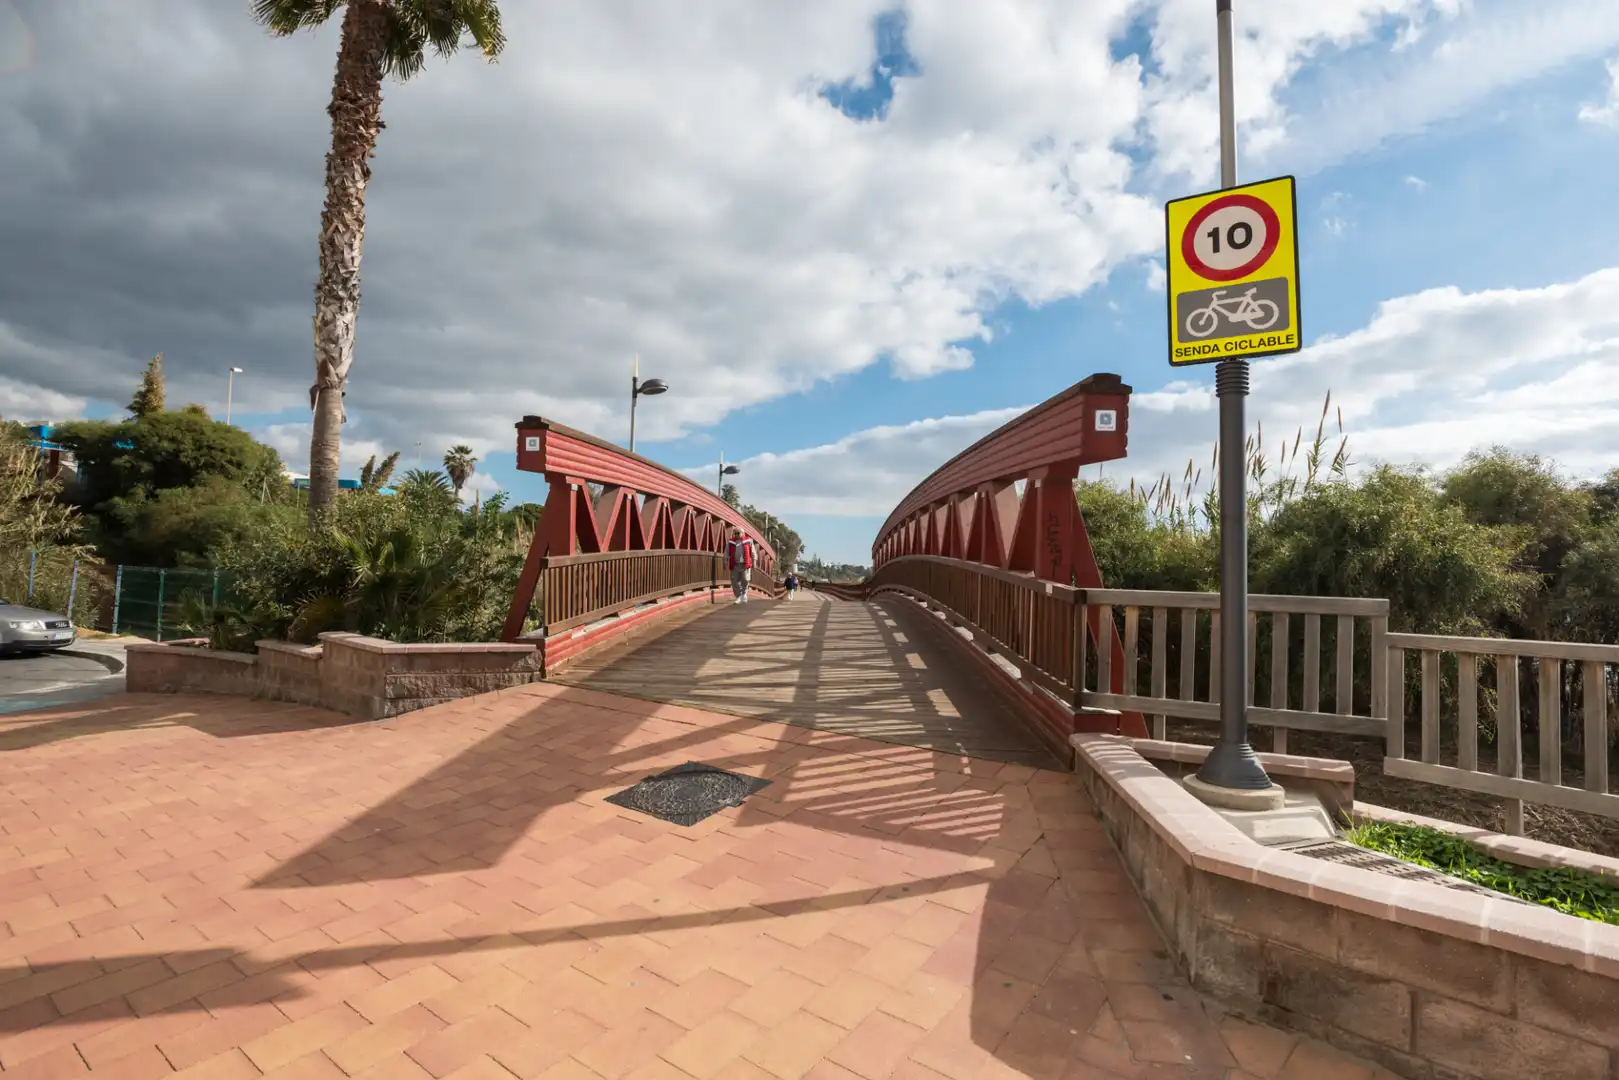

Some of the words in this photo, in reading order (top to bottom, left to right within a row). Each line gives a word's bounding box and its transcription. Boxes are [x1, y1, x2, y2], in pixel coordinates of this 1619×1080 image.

[1207, 222, 1252, 253] 10
[1175, 344, 1220, 357] SENDA
[1224, 334, 1294, 351] CICLABLE
